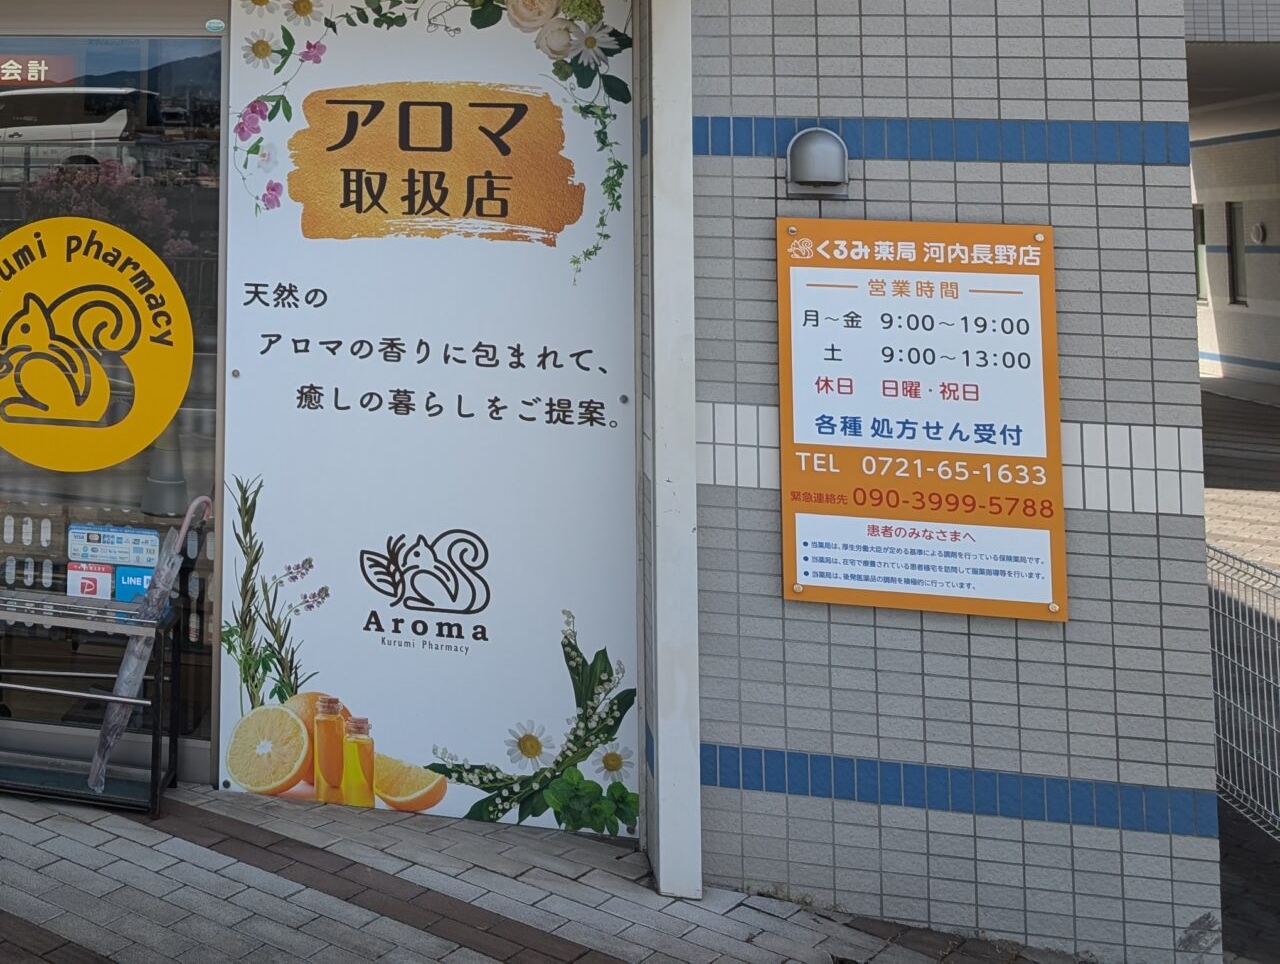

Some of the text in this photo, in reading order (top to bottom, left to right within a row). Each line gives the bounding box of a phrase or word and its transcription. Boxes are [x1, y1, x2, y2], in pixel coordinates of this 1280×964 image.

[324, 99, 529, 157] アロマ
[339, 168, 514, 219] 取扱店
[816, 239, 1041, 267] くるみ薬局 河内長野店
[65, 229, 174, 347] pharmacy
[243, 282, 327, 310] 天然の
[867, 279, 959, 299] 営業時間
[259, 332, 609, 375] アロマの香りに包まれて、
[823, 344, 843, 362] 土
[815, 376, 979, 402] 休日 日曜・祝日
[296, 383, 618, 429] 癒しの暮らしをご提案。
[795, 452, 1047, 485] TEL 0721-65-1633
[853, 487, 1054, 518] 090-3999-5788
[867, 524, 976, 543] 患者のみなさまへ
[121, 576, 142, 585] LINE
[363, 610, 489, 642] Aroma
[381, 637, 469, 656] Kurumi Pharmacy
